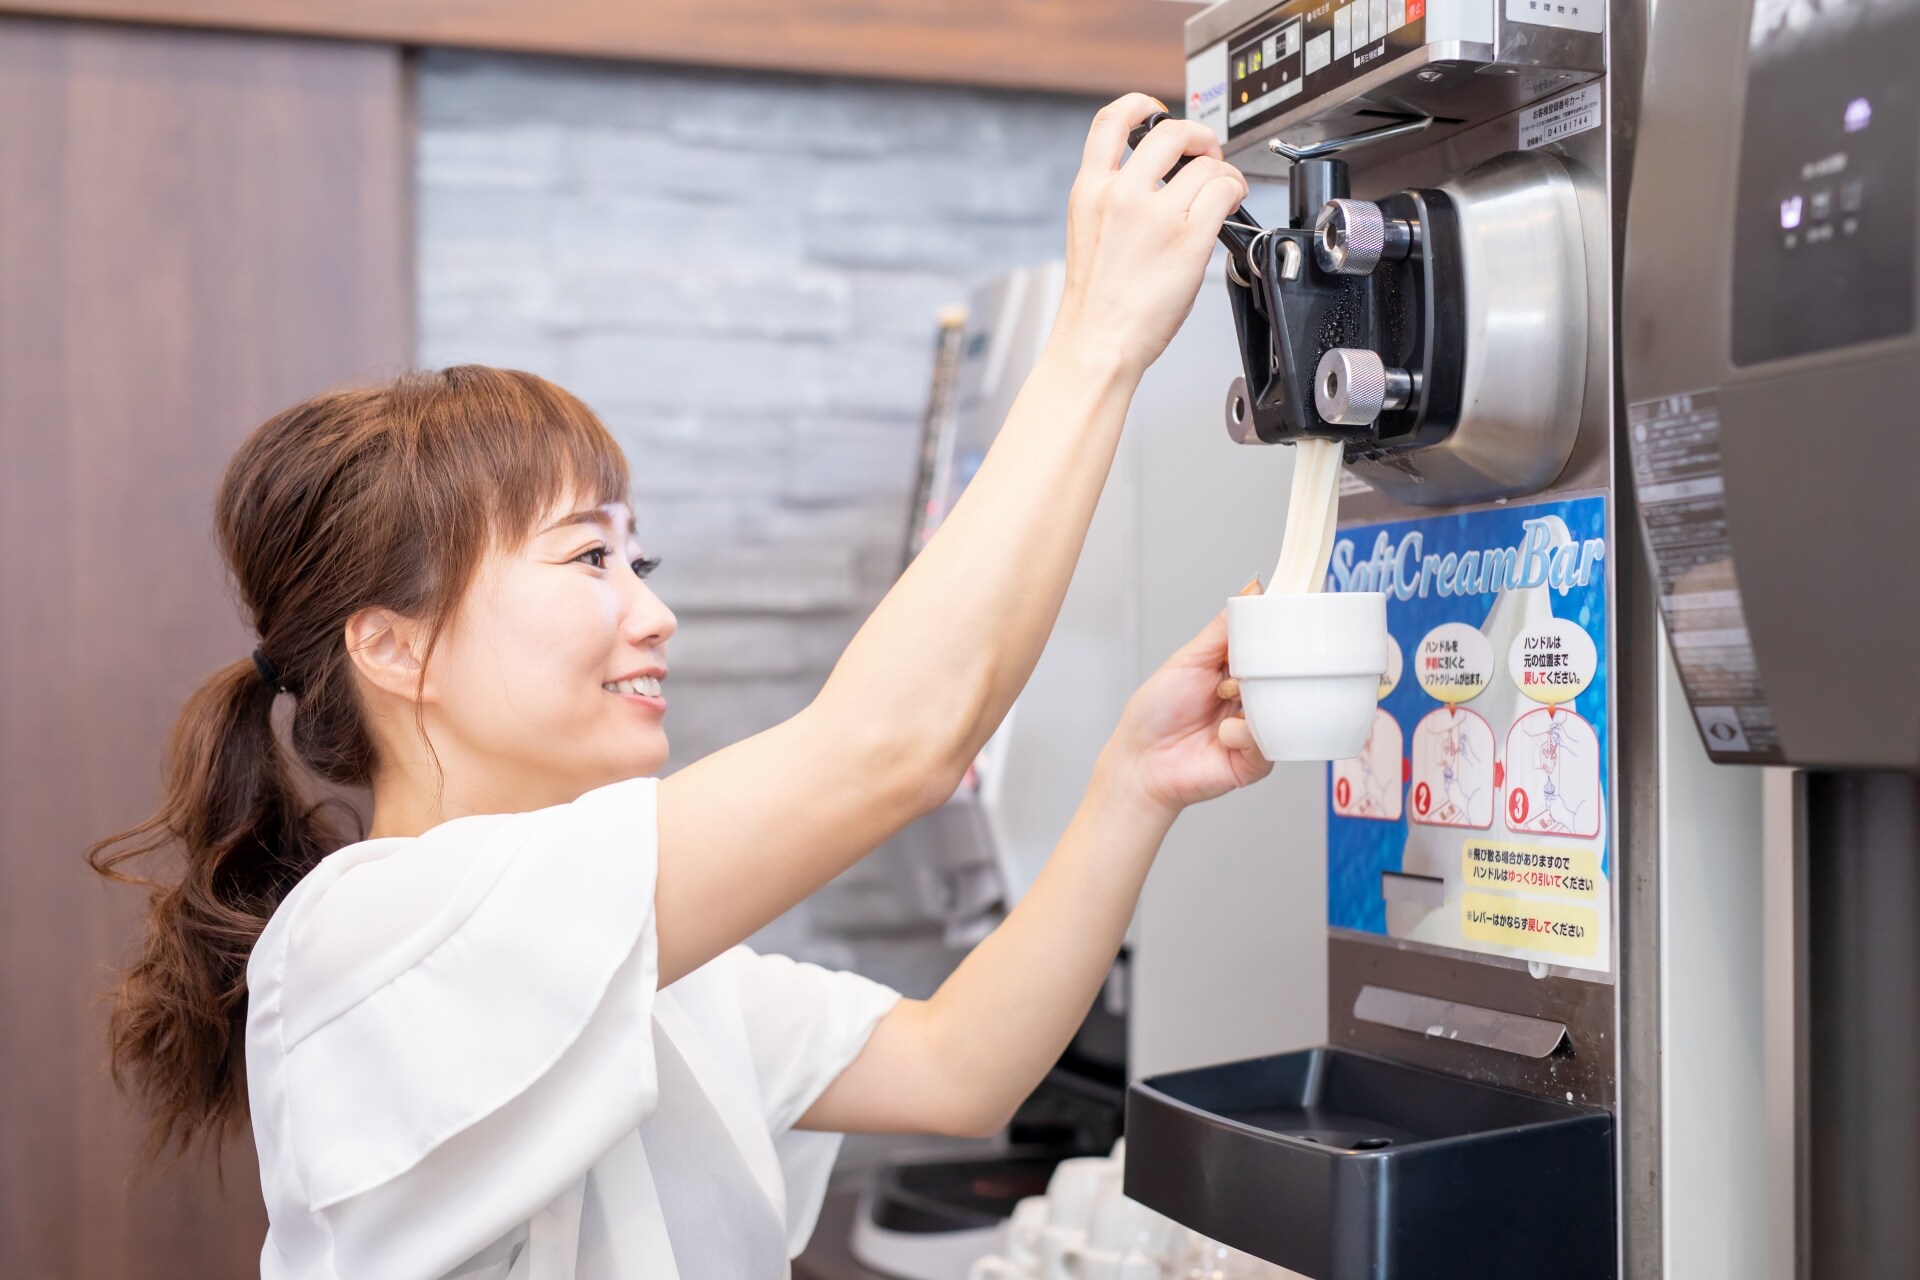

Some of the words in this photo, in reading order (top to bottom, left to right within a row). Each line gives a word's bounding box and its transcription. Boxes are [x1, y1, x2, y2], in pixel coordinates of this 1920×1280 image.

[1547, 116, 1588, 137] D4161744
[1425, 640, 1458, 653] ハンドルを
[1524, 636, 1561, 649] ハンドルは
[1425, 656, 1465, 670] 手前に引くと
[1524, 653, 1568, 668] 元の位置まで
[1524, 671, 1580, 685] 戻してください。
[1473, 866, 1593, 891] ハンドルはゆっくり引いてください
